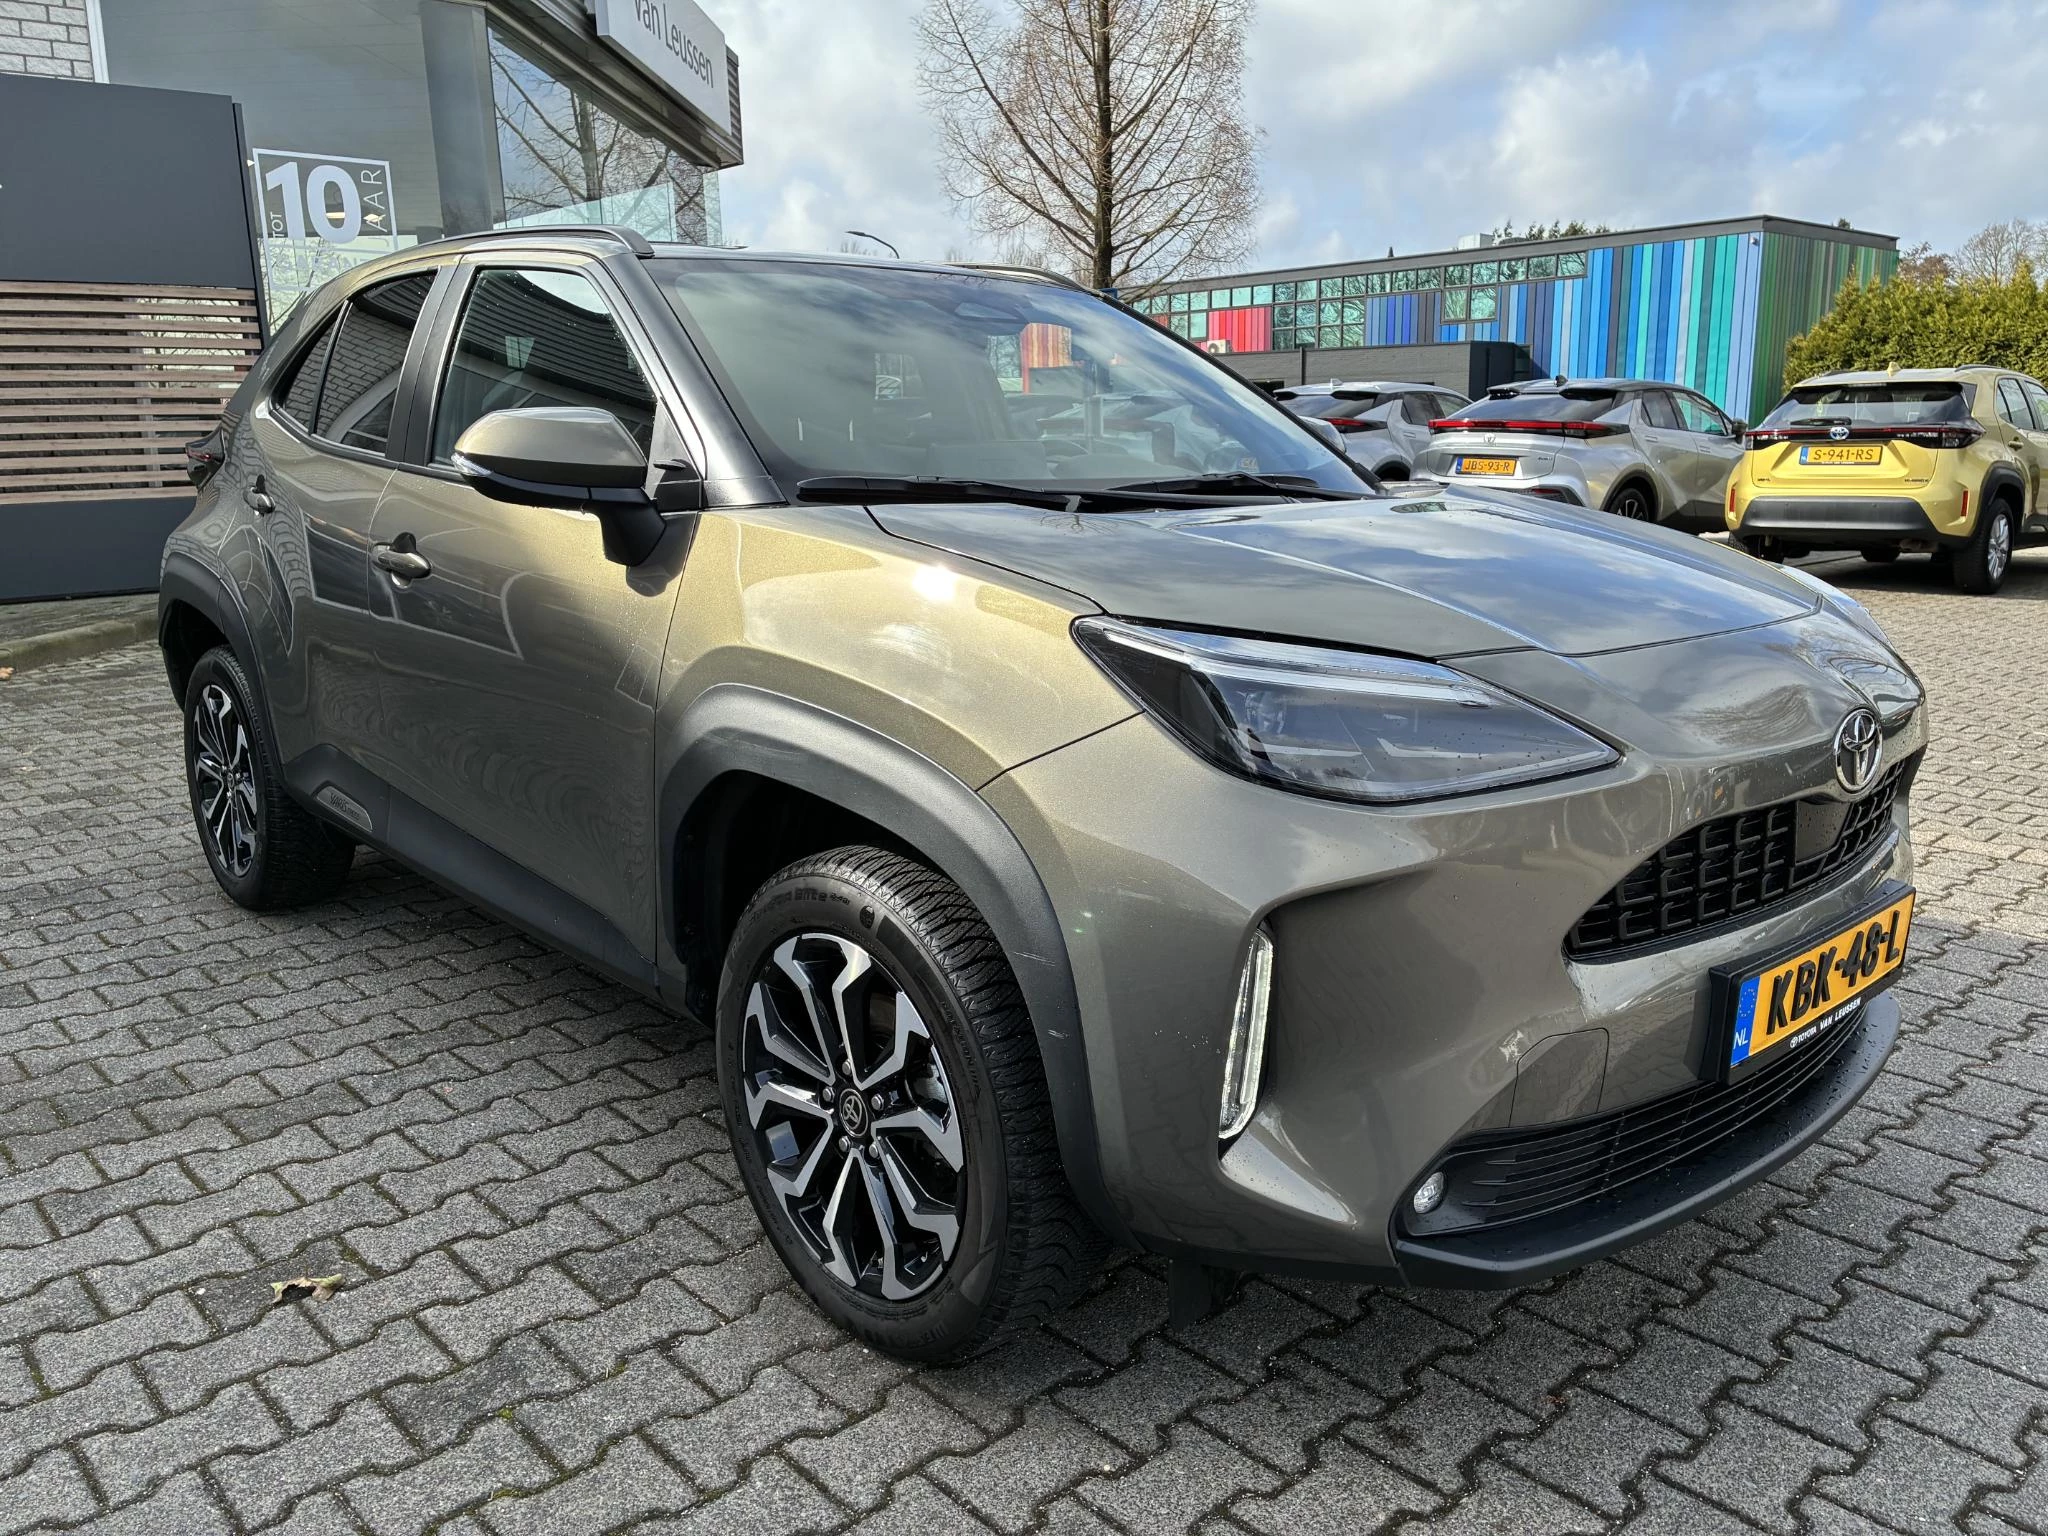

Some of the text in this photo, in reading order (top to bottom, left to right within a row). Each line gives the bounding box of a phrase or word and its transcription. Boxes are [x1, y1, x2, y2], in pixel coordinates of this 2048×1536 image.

[662, 3, 714, 88] Leussen
[265, 161, 362, 245] 10
[270, 211, 286, 238] TOT
[1465, 460, 1510, 471] JBS-93-R
[1813, 448, 1874, 461] S-941-RS
[1766, 909, 1900, 1036] KBK-48-L
[1797, 996, 1862, 1043] TOYOTA VAN LEUSSEN
[1733, 1028, 1749, 1050] NL
